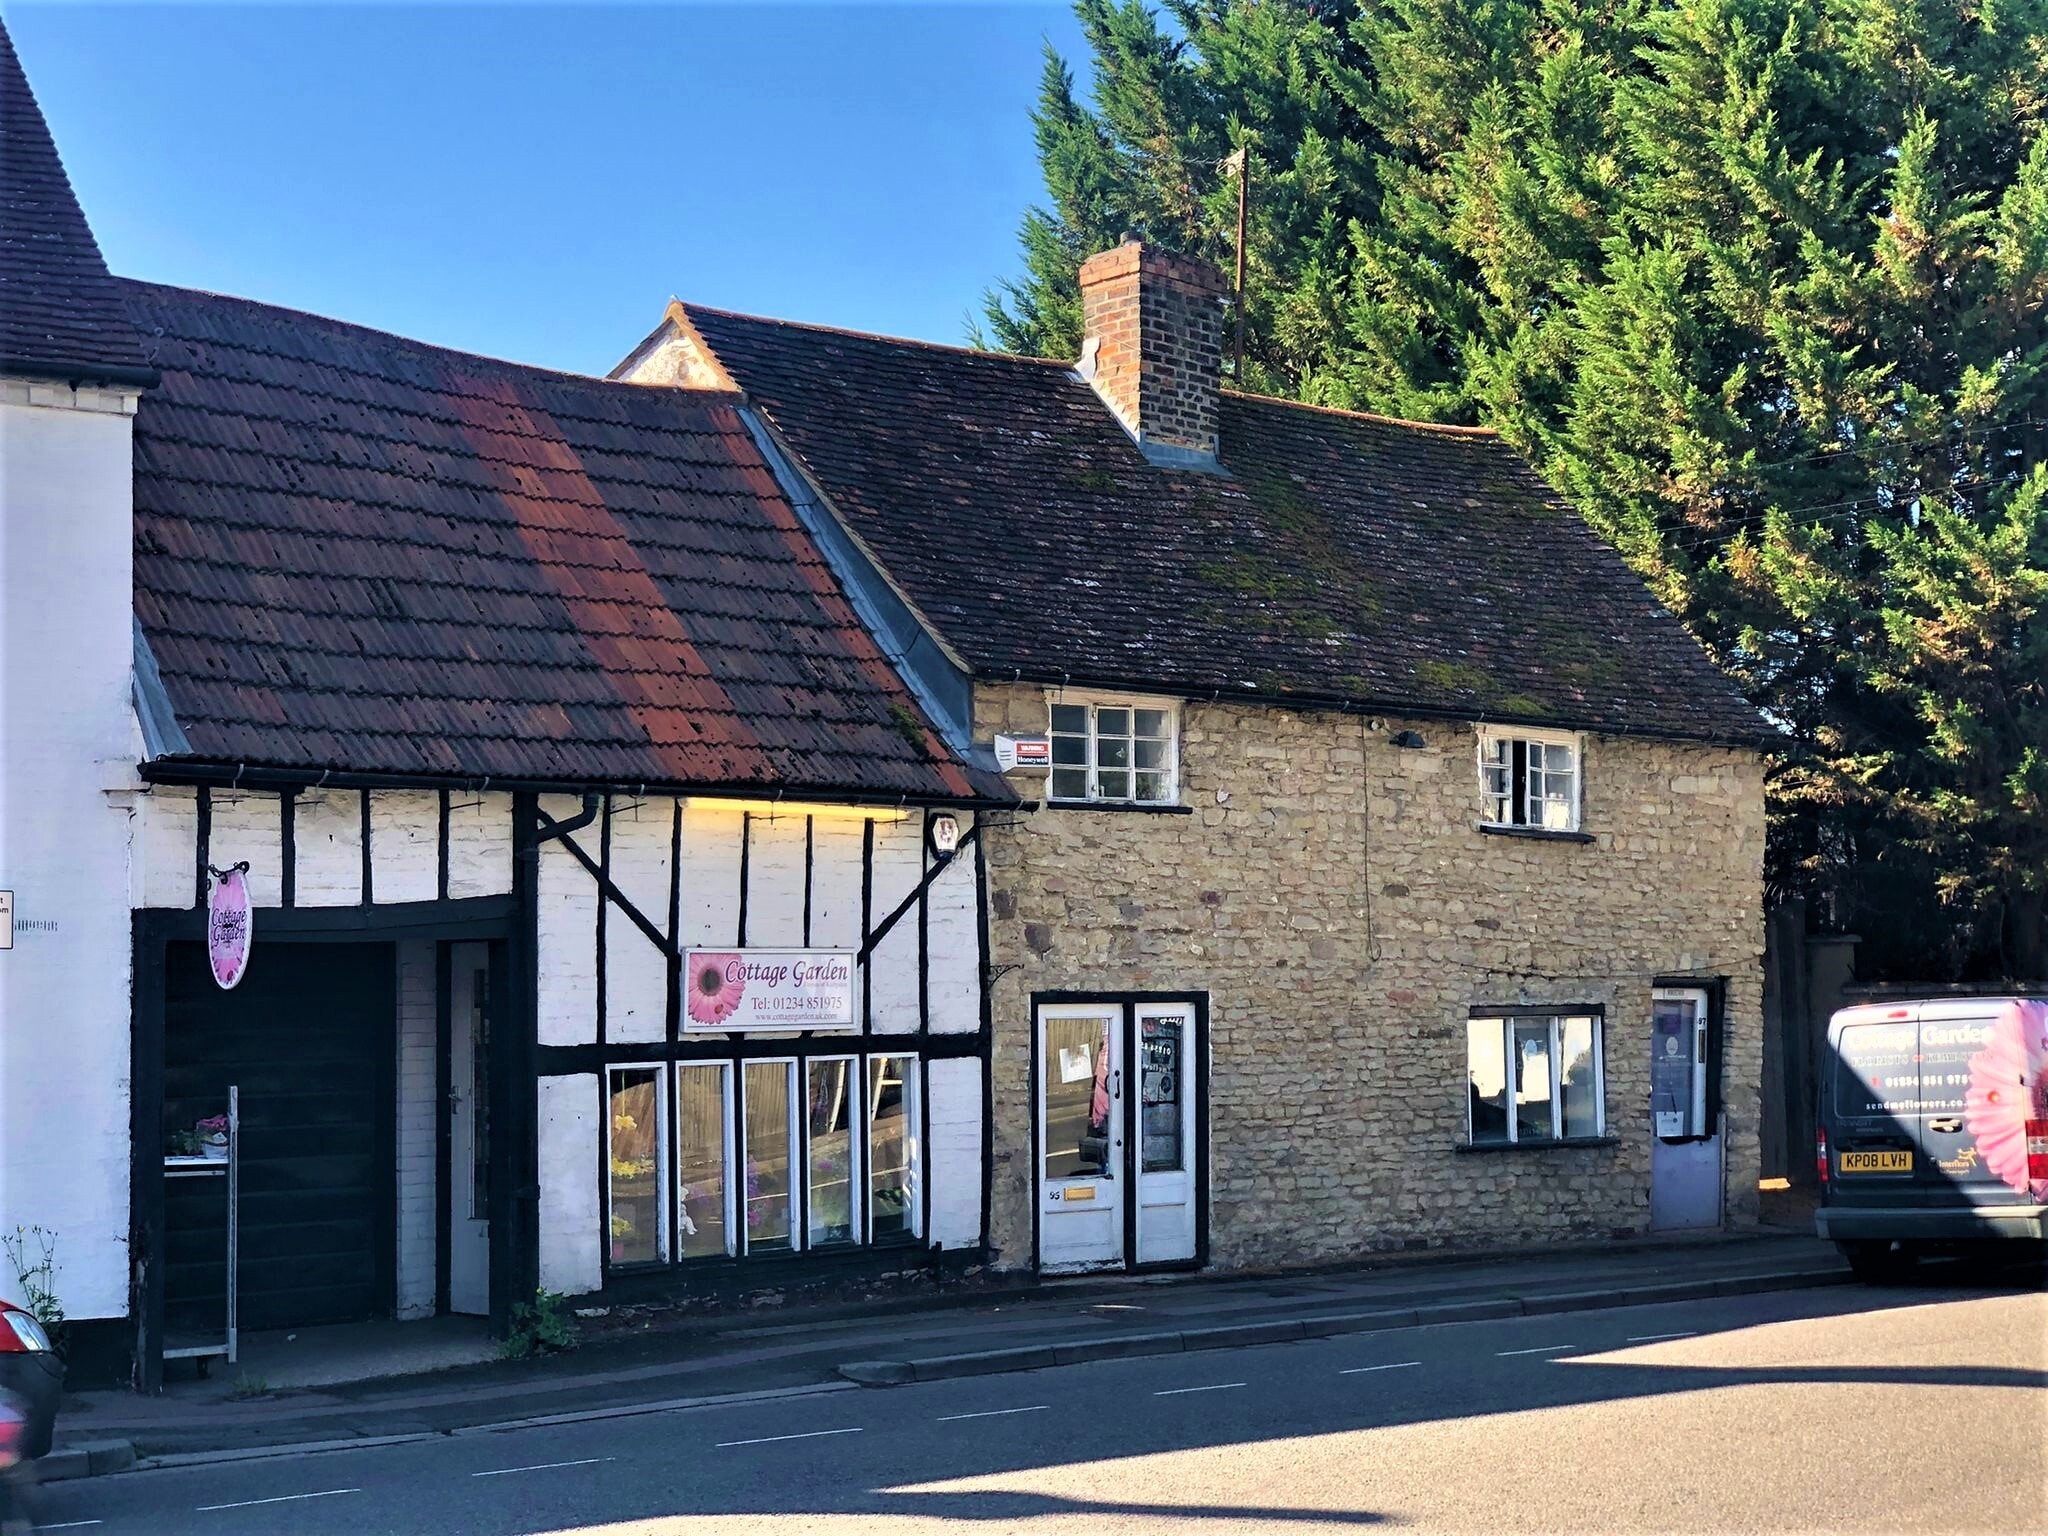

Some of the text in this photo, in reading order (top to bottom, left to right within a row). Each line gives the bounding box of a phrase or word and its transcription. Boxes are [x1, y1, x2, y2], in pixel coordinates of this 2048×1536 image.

[1017, 756, 1048, 764] Honeywell
[211, 908, 247, 930] Cottage
[213, 925, 245, 947] Garden
[725, 958, 848, 988] Cottage Garden
[751, 997, 842, 1010] Tel: 01234 851975
[1866, 1098, 1980, 1111] sendmeflowers.co.
[1846, 1153, 1907, 1168] KP08 LVH
